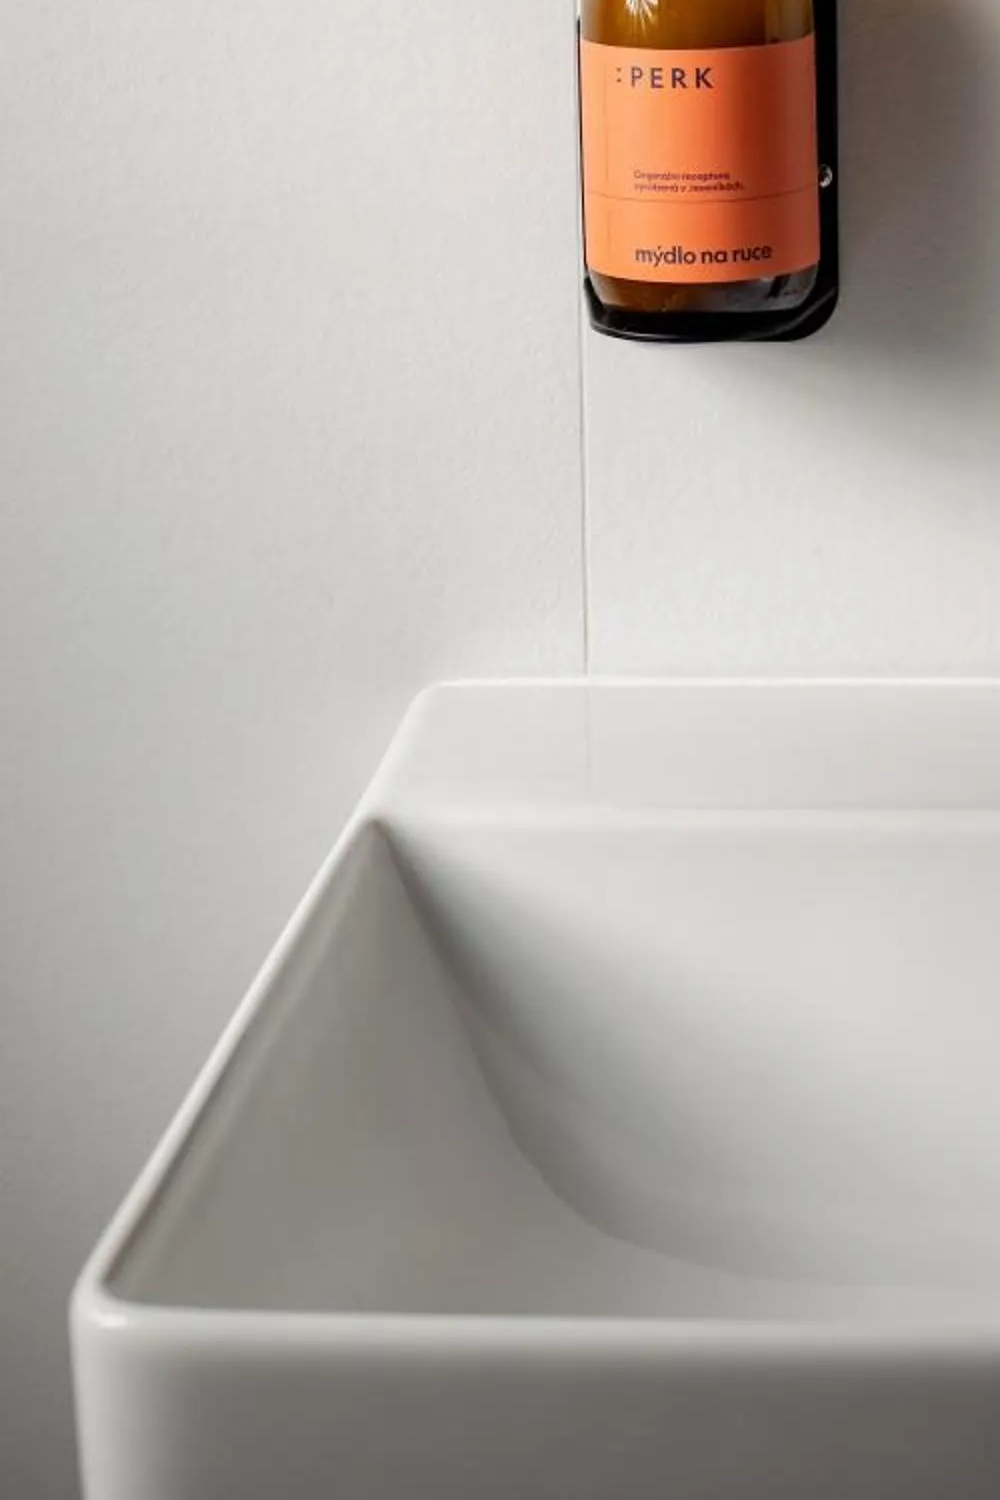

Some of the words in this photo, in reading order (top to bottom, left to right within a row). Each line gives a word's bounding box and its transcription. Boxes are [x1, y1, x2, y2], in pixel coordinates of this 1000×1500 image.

[635, 245, 697, 268] mýdlo
[701, 250, 728, 264] na
[732, 245, 773, 263] ruce
